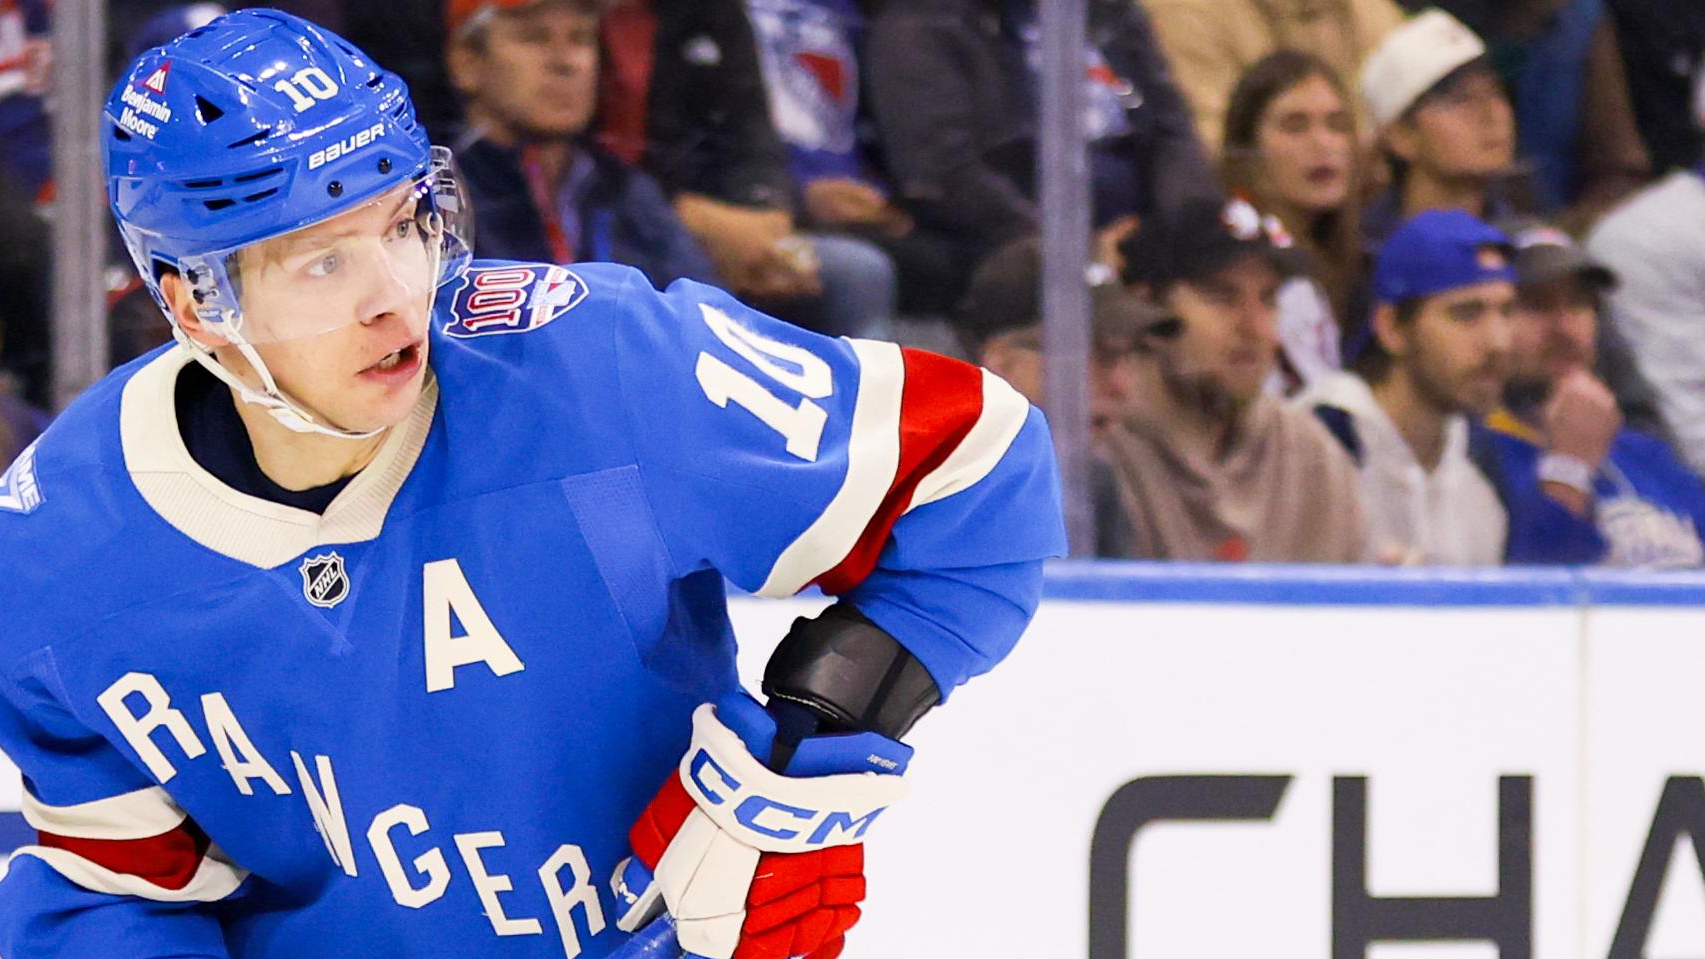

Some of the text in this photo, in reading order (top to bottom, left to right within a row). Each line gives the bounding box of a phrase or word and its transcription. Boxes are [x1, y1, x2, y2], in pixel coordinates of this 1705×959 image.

[121, 84, 171, 123] Benjamin
[275, 67, 339, 113] 10
[120, 106, 155, 140] Moore
[308, 122, 386, 170] BAUER
[463, 268, 536, 331] 100
[695, 303, 833, 462] 10
[314, 566, 338, 599] NHL
[423, 558, 525, 693] A
[689, 747, 890, 845] CCM
